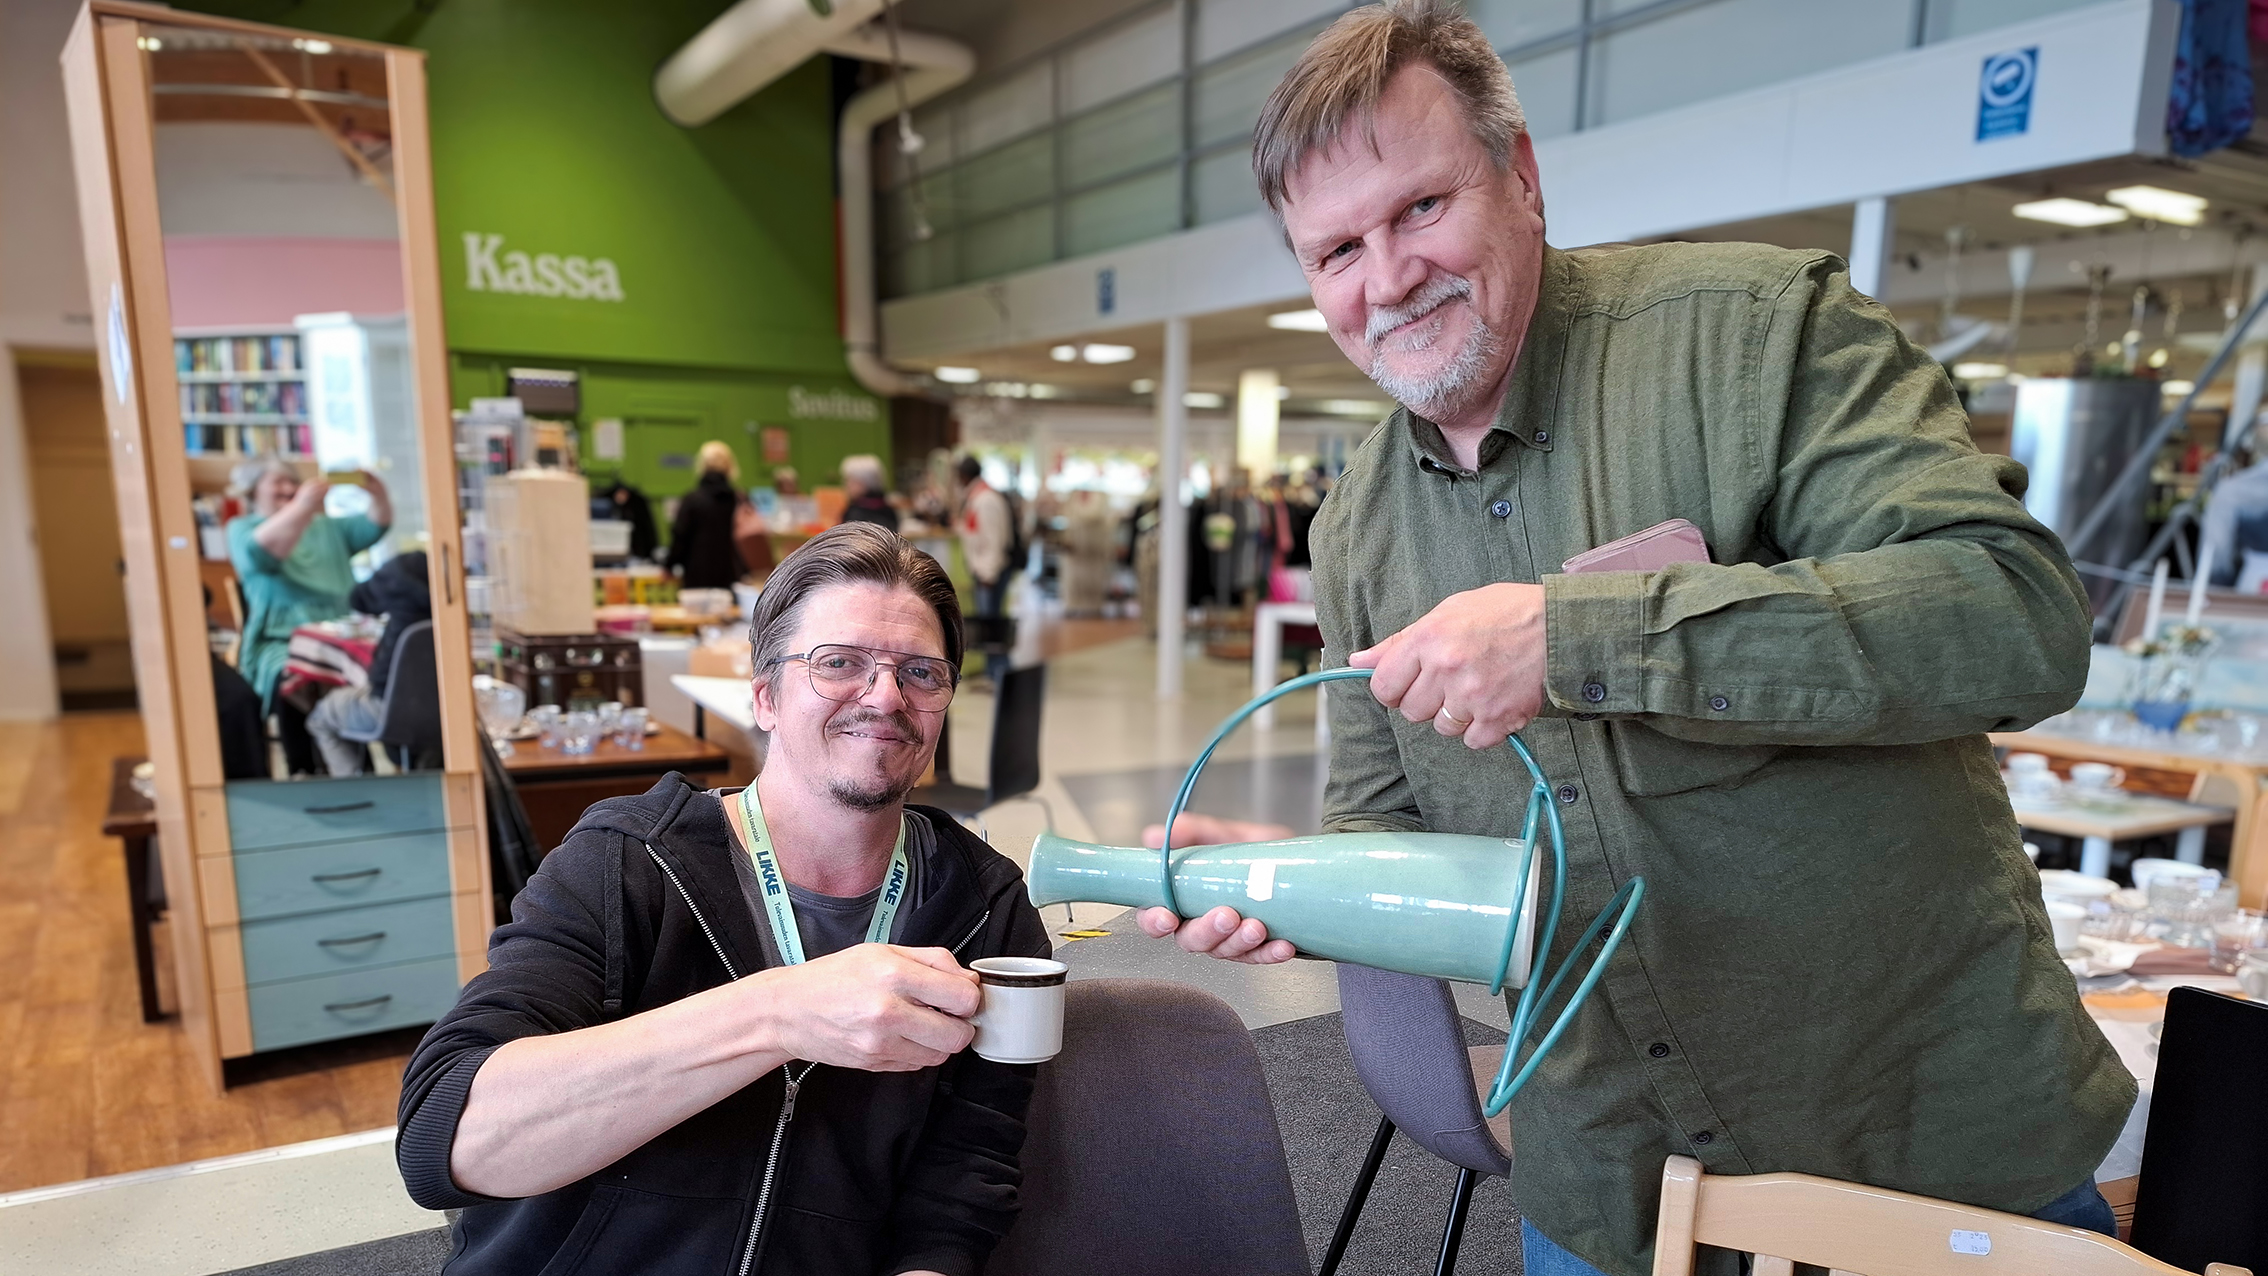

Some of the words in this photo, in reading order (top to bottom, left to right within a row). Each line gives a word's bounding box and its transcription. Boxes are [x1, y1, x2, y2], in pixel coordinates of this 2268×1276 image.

[461, 231, 626, 302] Kassa
[756, 850, 781, 896] LIKKE
[784, 940, 797, 966] tavaratal
[884, 859, 905, 906] LIKKE
